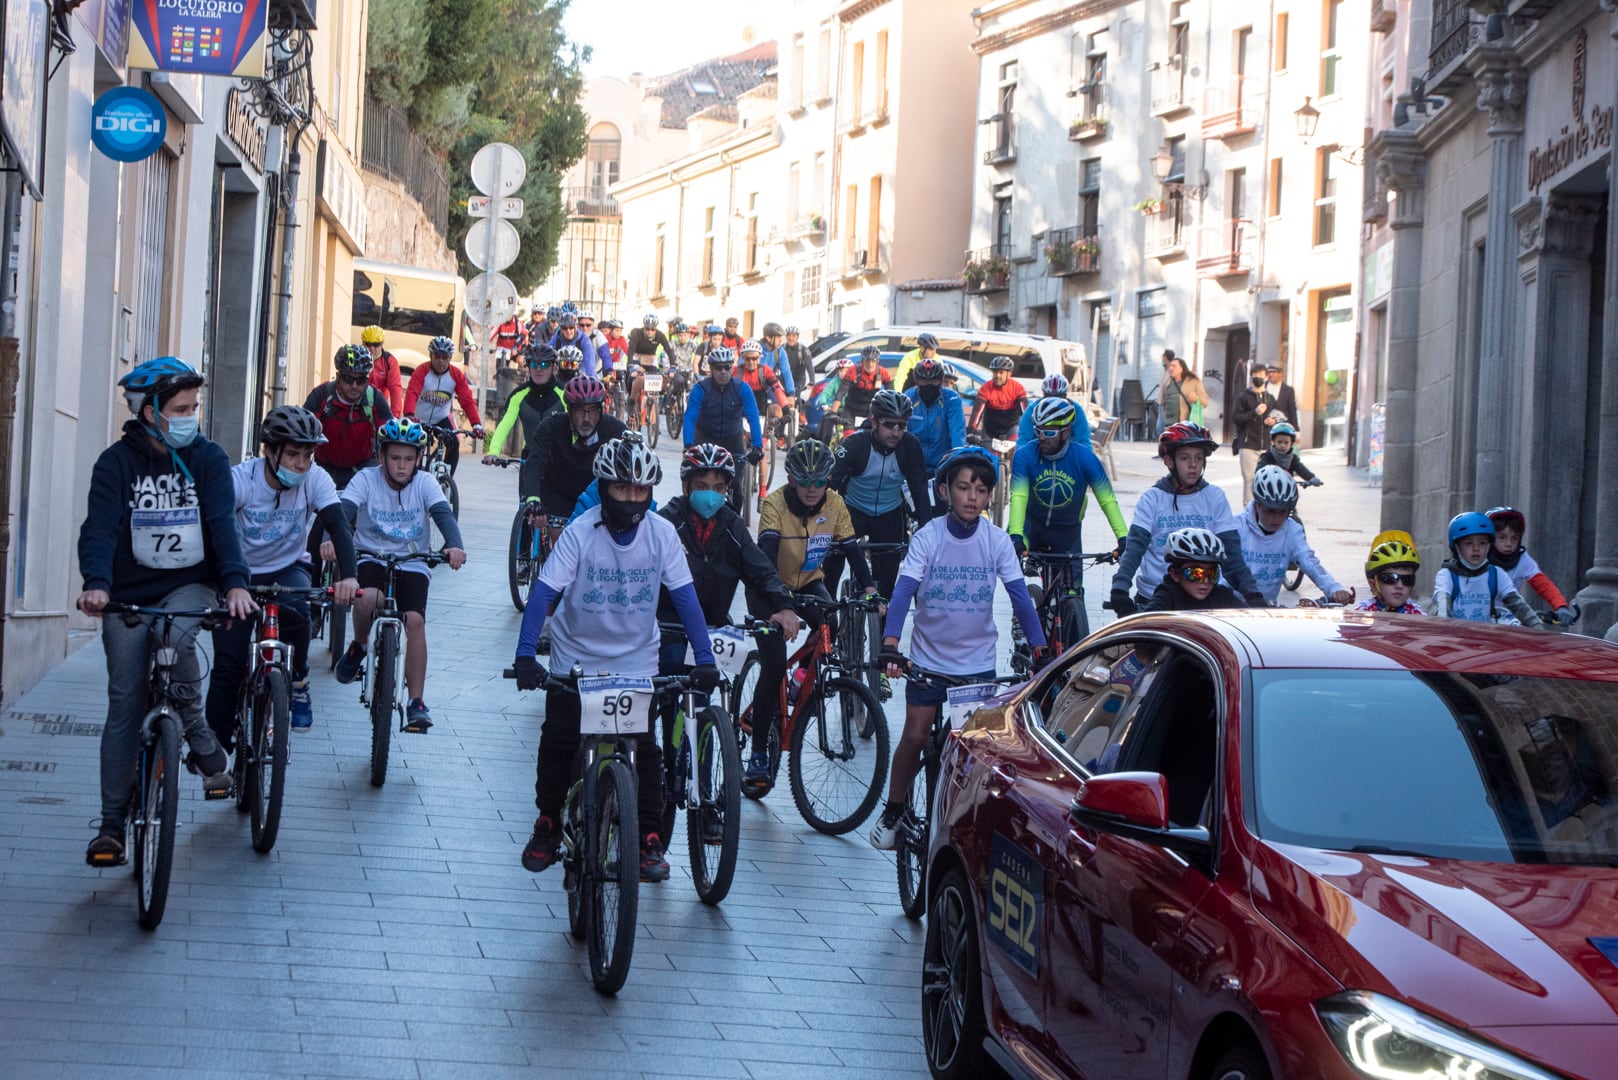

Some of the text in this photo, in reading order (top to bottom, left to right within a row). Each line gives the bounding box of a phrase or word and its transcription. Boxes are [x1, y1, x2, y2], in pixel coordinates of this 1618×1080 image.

[158, 0, 243, 14] LOCUTORIO
[179, 9, 222, 19] LA CALERA
[95, 116, 160, 133] DIGI
[131, 473, 181, 494] JACK
[129, 488, 199, 510] JONES
[151, 533, 183, 552] 72
[935, 572, 988, 581] SEGOVIA 2021
[949, 565, 958, 573] LA
[596, 575, 628, 585] SEGOVIA
[629, 575, 648, 583] 2021
[713, 638, 736, 658] 81
[602, 695, 633, 716] 59
[990, 867, 1036, 957] SER
